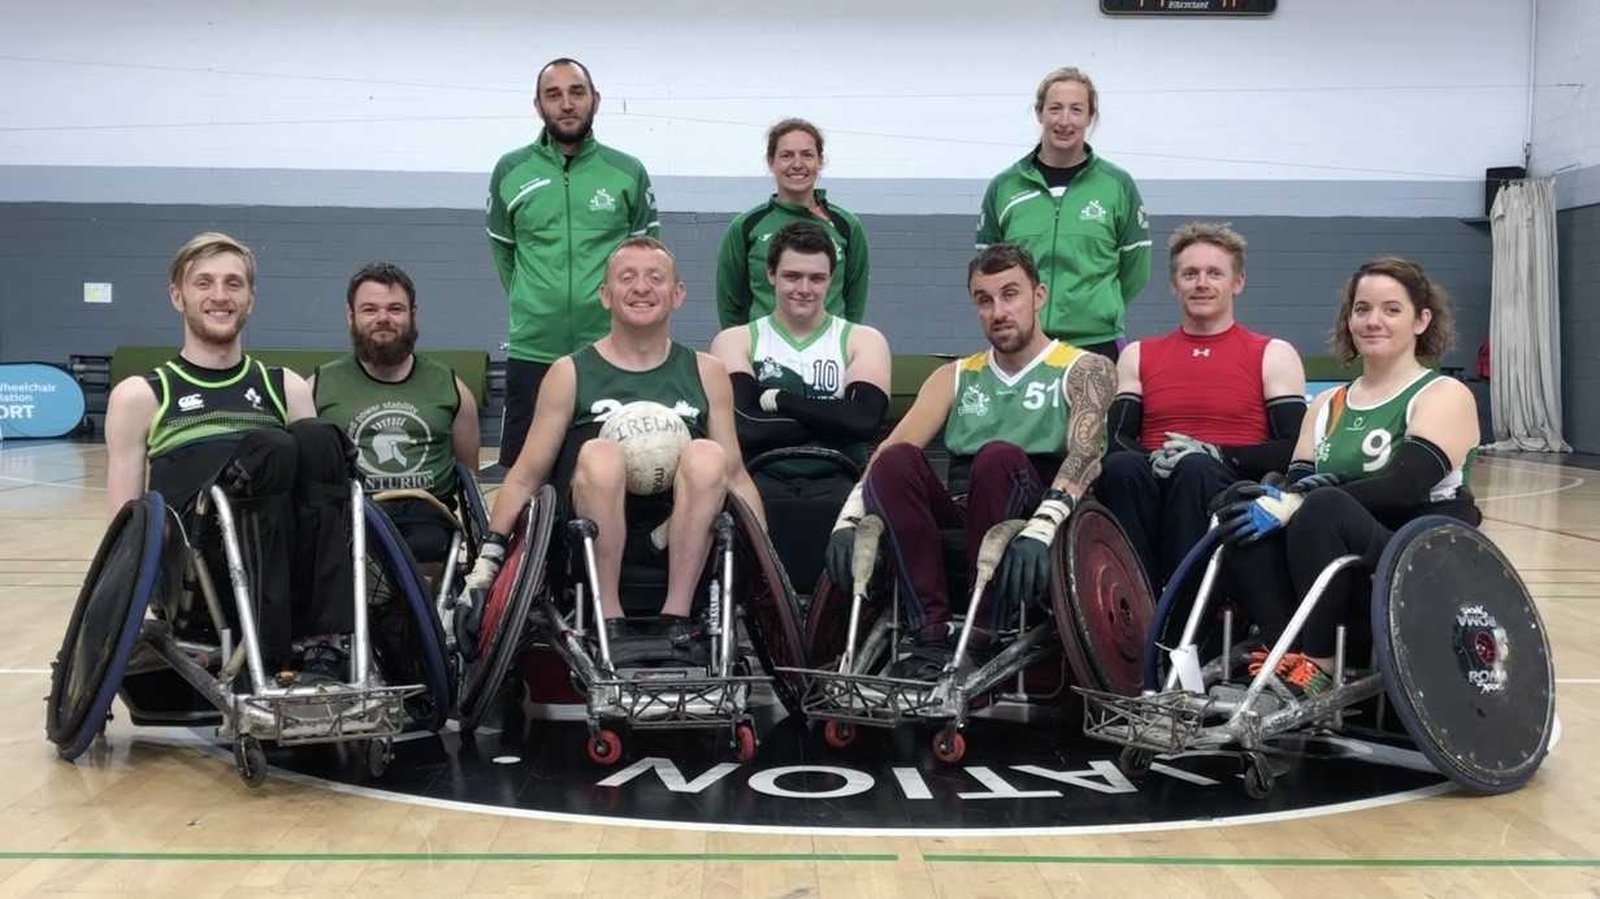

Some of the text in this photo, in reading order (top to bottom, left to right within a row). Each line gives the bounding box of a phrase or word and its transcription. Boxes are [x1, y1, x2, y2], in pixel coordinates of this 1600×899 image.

[813, 359, 839, 392] 10
[1022, 378, 1062, 410] 51
[616, 415, 686, 441] IRELAN
[1362, 428, 1392, 472] 9
